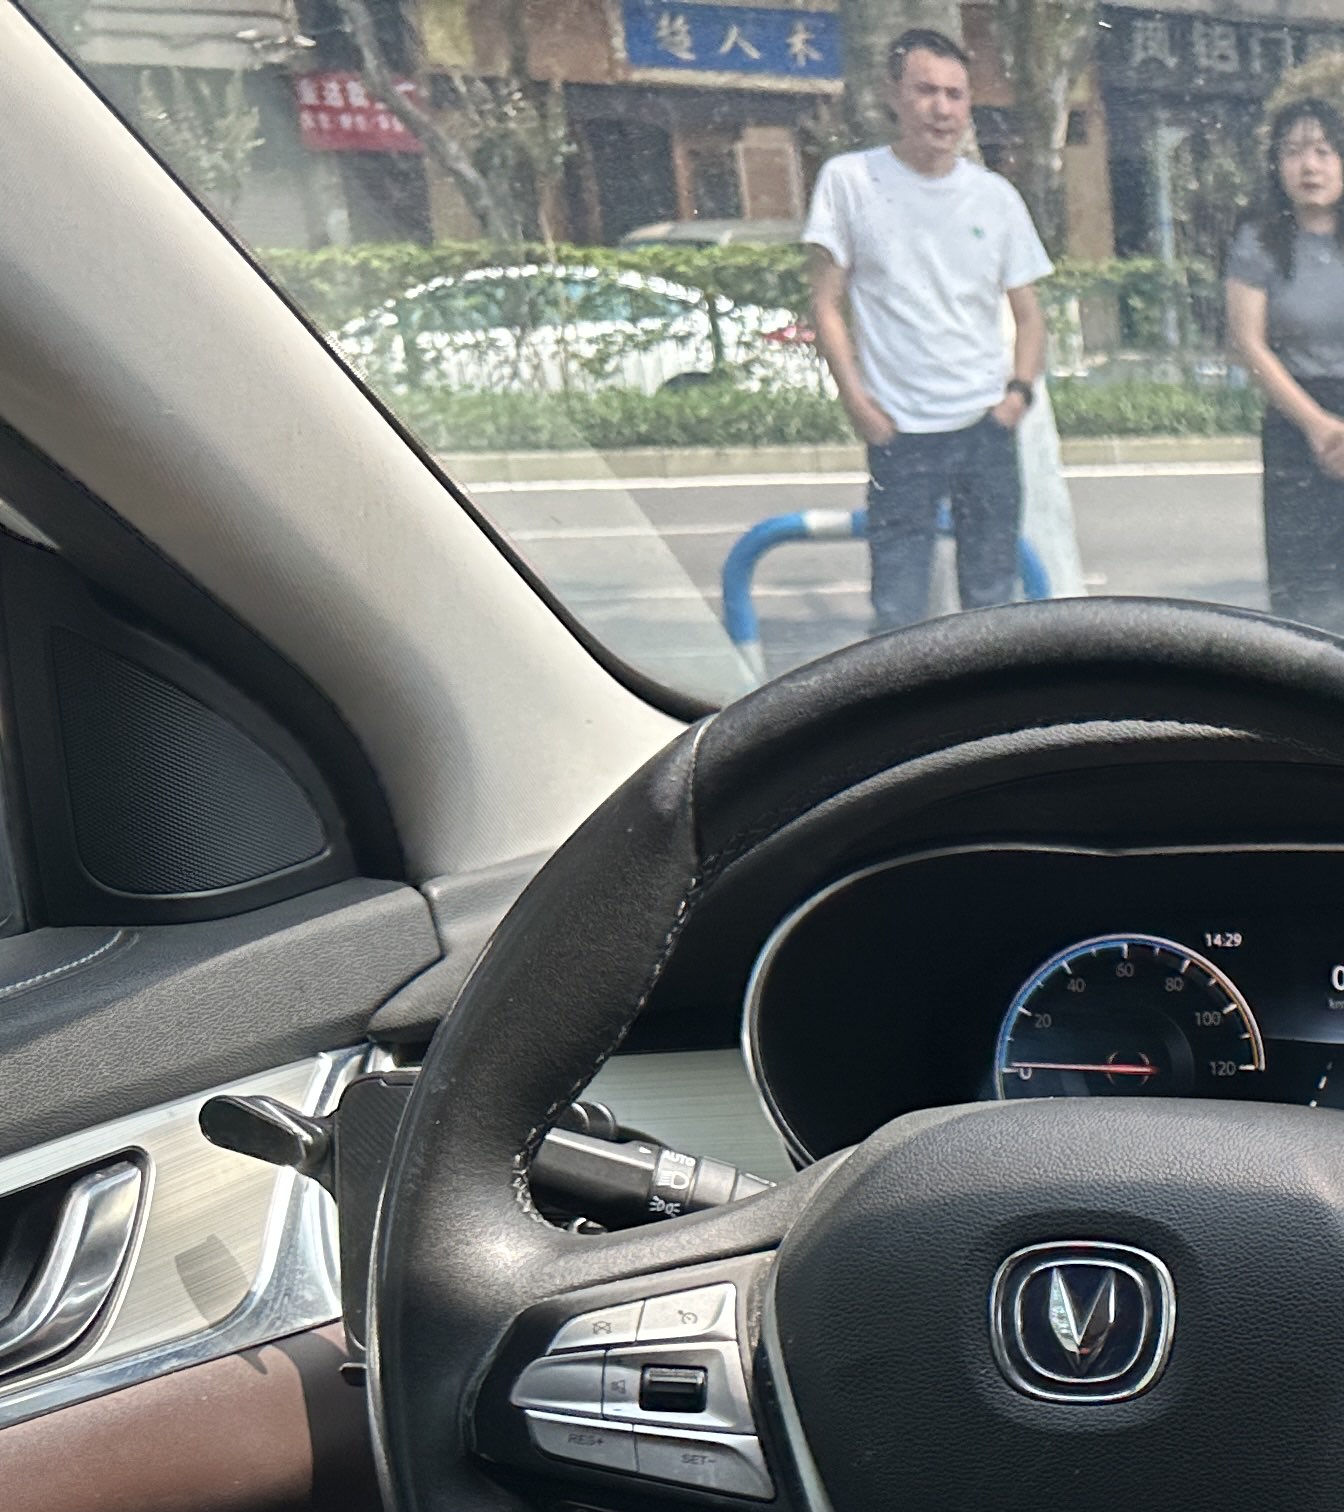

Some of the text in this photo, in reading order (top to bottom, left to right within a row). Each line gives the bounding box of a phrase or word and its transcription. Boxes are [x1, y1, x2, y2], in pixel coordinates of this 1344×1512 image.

[1204, 932, 1242, 948] 14:29
[1115, 963, 1135, 978] 60
[1066, 977, 1086, 993] 40
[1164, 976, 1184, 992] 80
[1034, 1013, 1051, 1029] 20
[1195, 1010, 1222, 1026] 100
[1210, 1061, 1236, 1077] 120
[661, 1149, 696, 1167] AUTO
[567, 1433, 604, 1446] RES+
